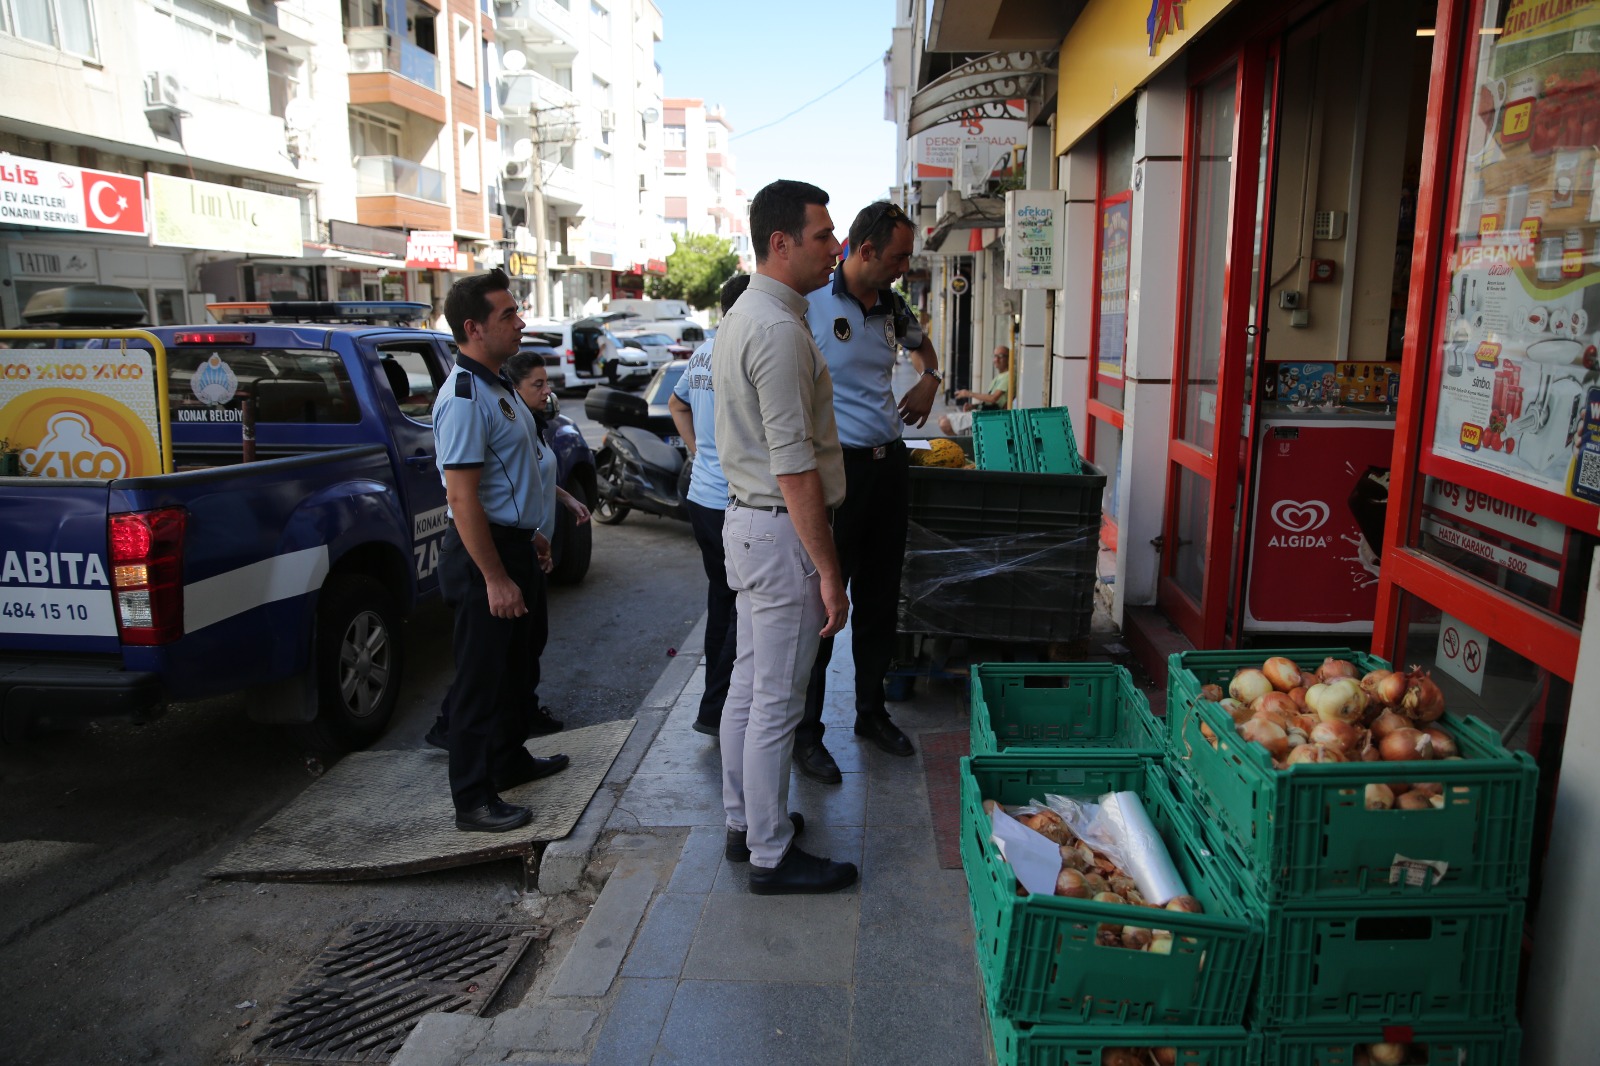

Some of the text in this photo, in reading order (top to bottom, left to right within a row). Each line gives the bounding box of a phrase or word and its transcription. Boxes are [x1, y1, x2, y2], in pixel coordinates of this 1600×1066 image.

[4, 191, 66, 209] EV ALETLERİ
[1, 206, 79, 224] ONARIM SERVİSİ
[91, 363, 144, 380] %100
[178, 410, 207, 421] KONAK
[416, 513, 442, 535] KONAK
[414, 536, 446, 581] ZA
[1439, 526, 1461, 544] HATAY
[1462, 536, 1495, 560] KARAKOL
[1507, 556, 1538, 573] 5002
[0, 551, 110, 586] ABITA
[3, 601, 88, 621] 484 15 10
